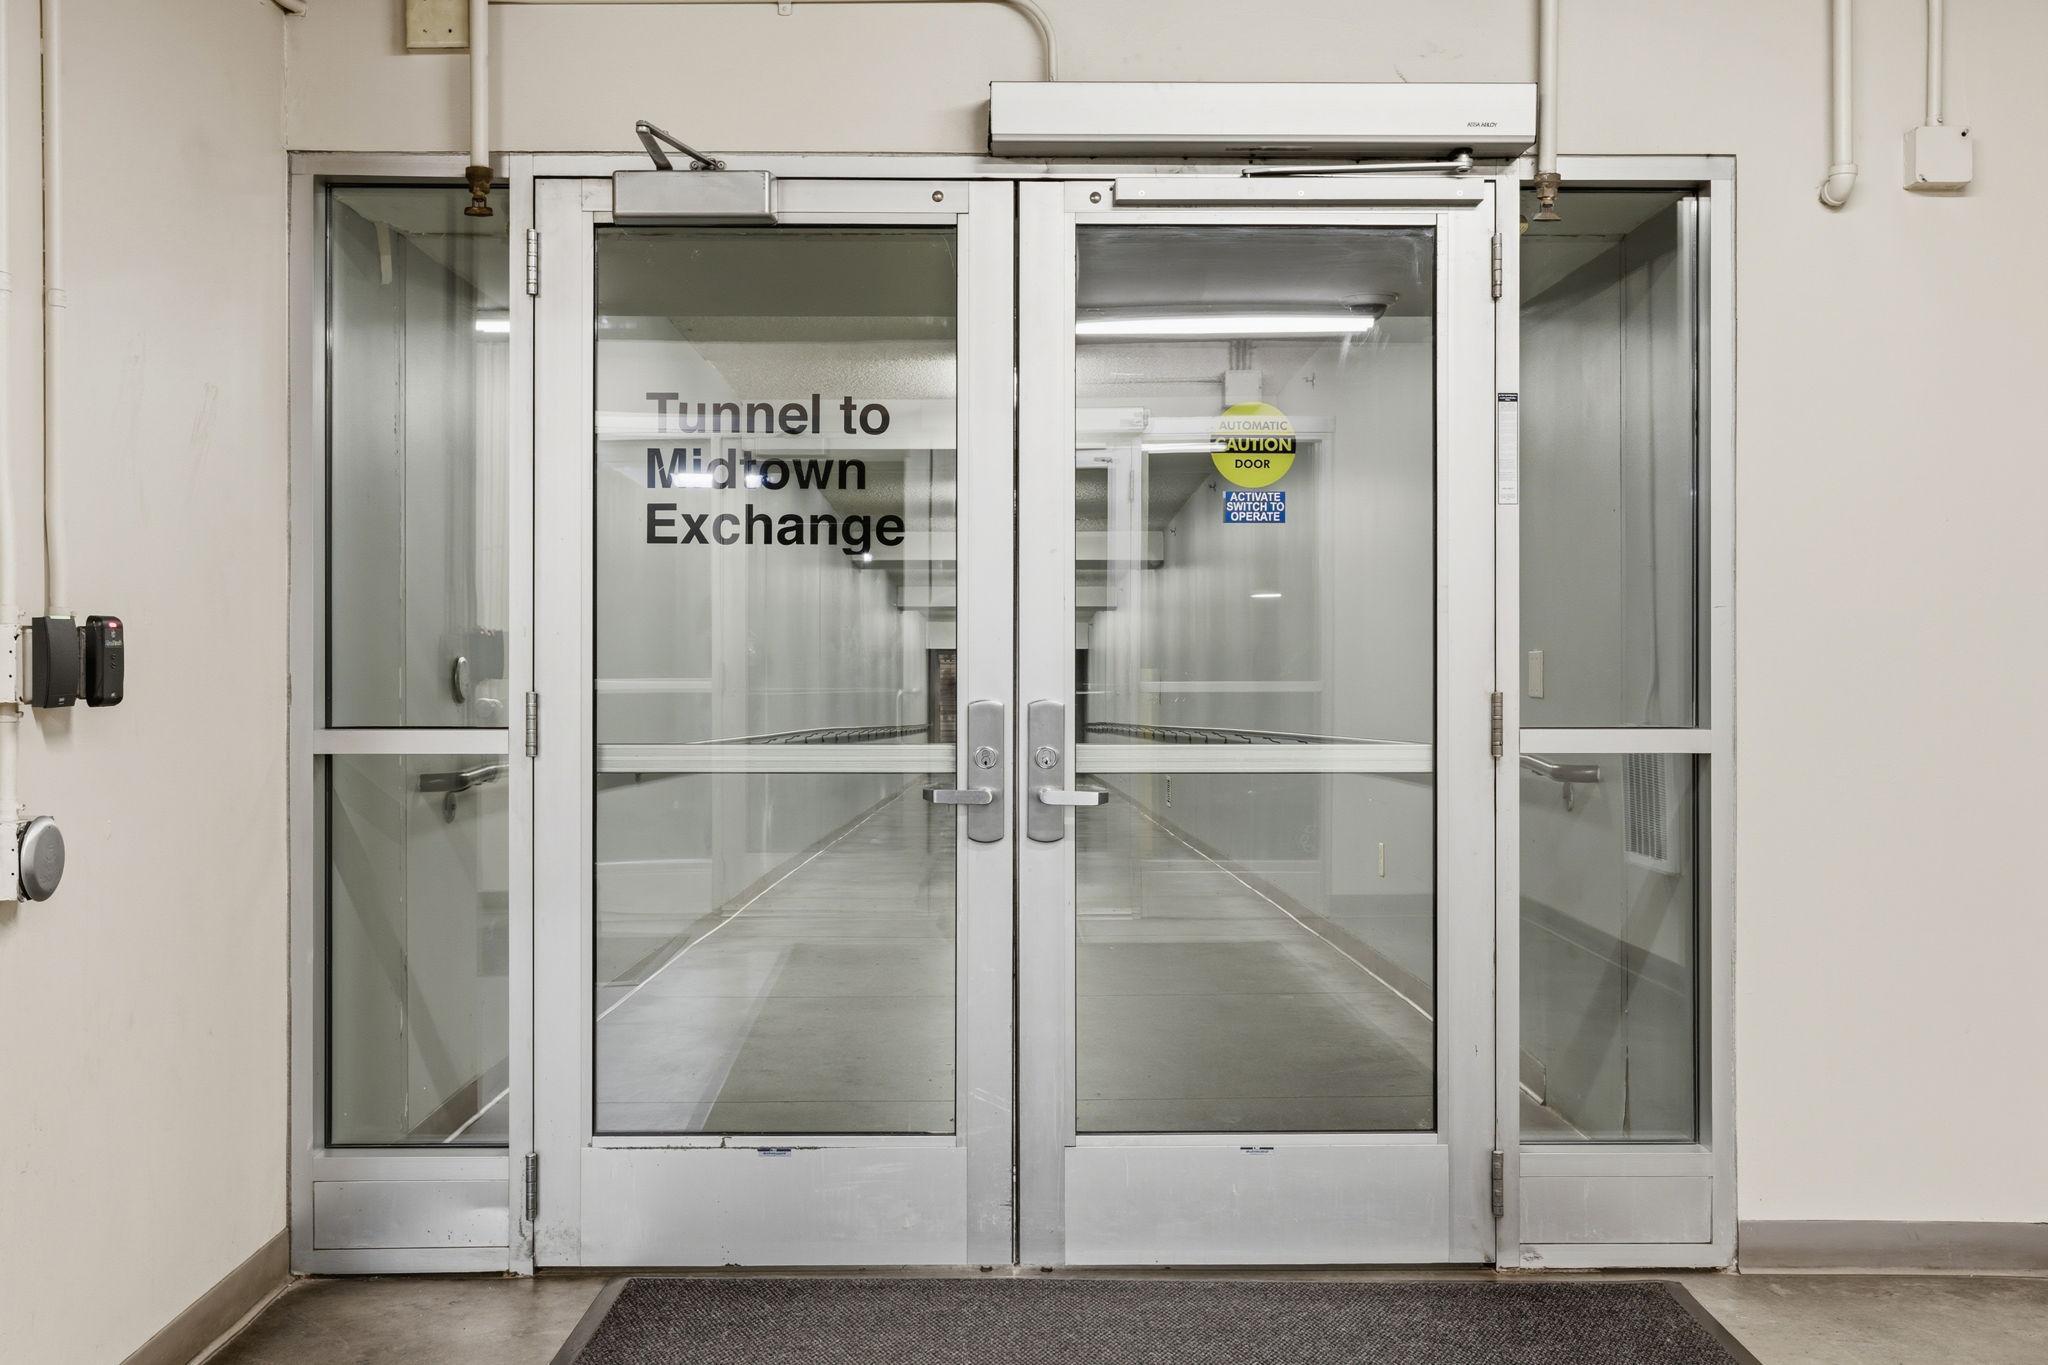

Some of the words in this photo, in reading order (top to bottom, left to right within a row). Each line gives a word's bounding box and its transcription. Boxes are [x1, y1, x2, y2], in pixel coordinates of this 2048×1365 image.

[646, 392, 820, 434] Tunnel
[840, 396, 890, 435] to
[1220, 421, 1288, 430] AUTOMATIC
[647, 448, 866, 490] Midtown
[1235, 460, 1270, 469] DOOR
[1230, 492, 1280, 501] ACTIVATE
[1226, 502, 1267, 511] SWITCH
[1270, 502, 1285, 511] TO
[1231, 512, 1280, 521] OPERATE
[646, 503, 905, 555] Exchange
